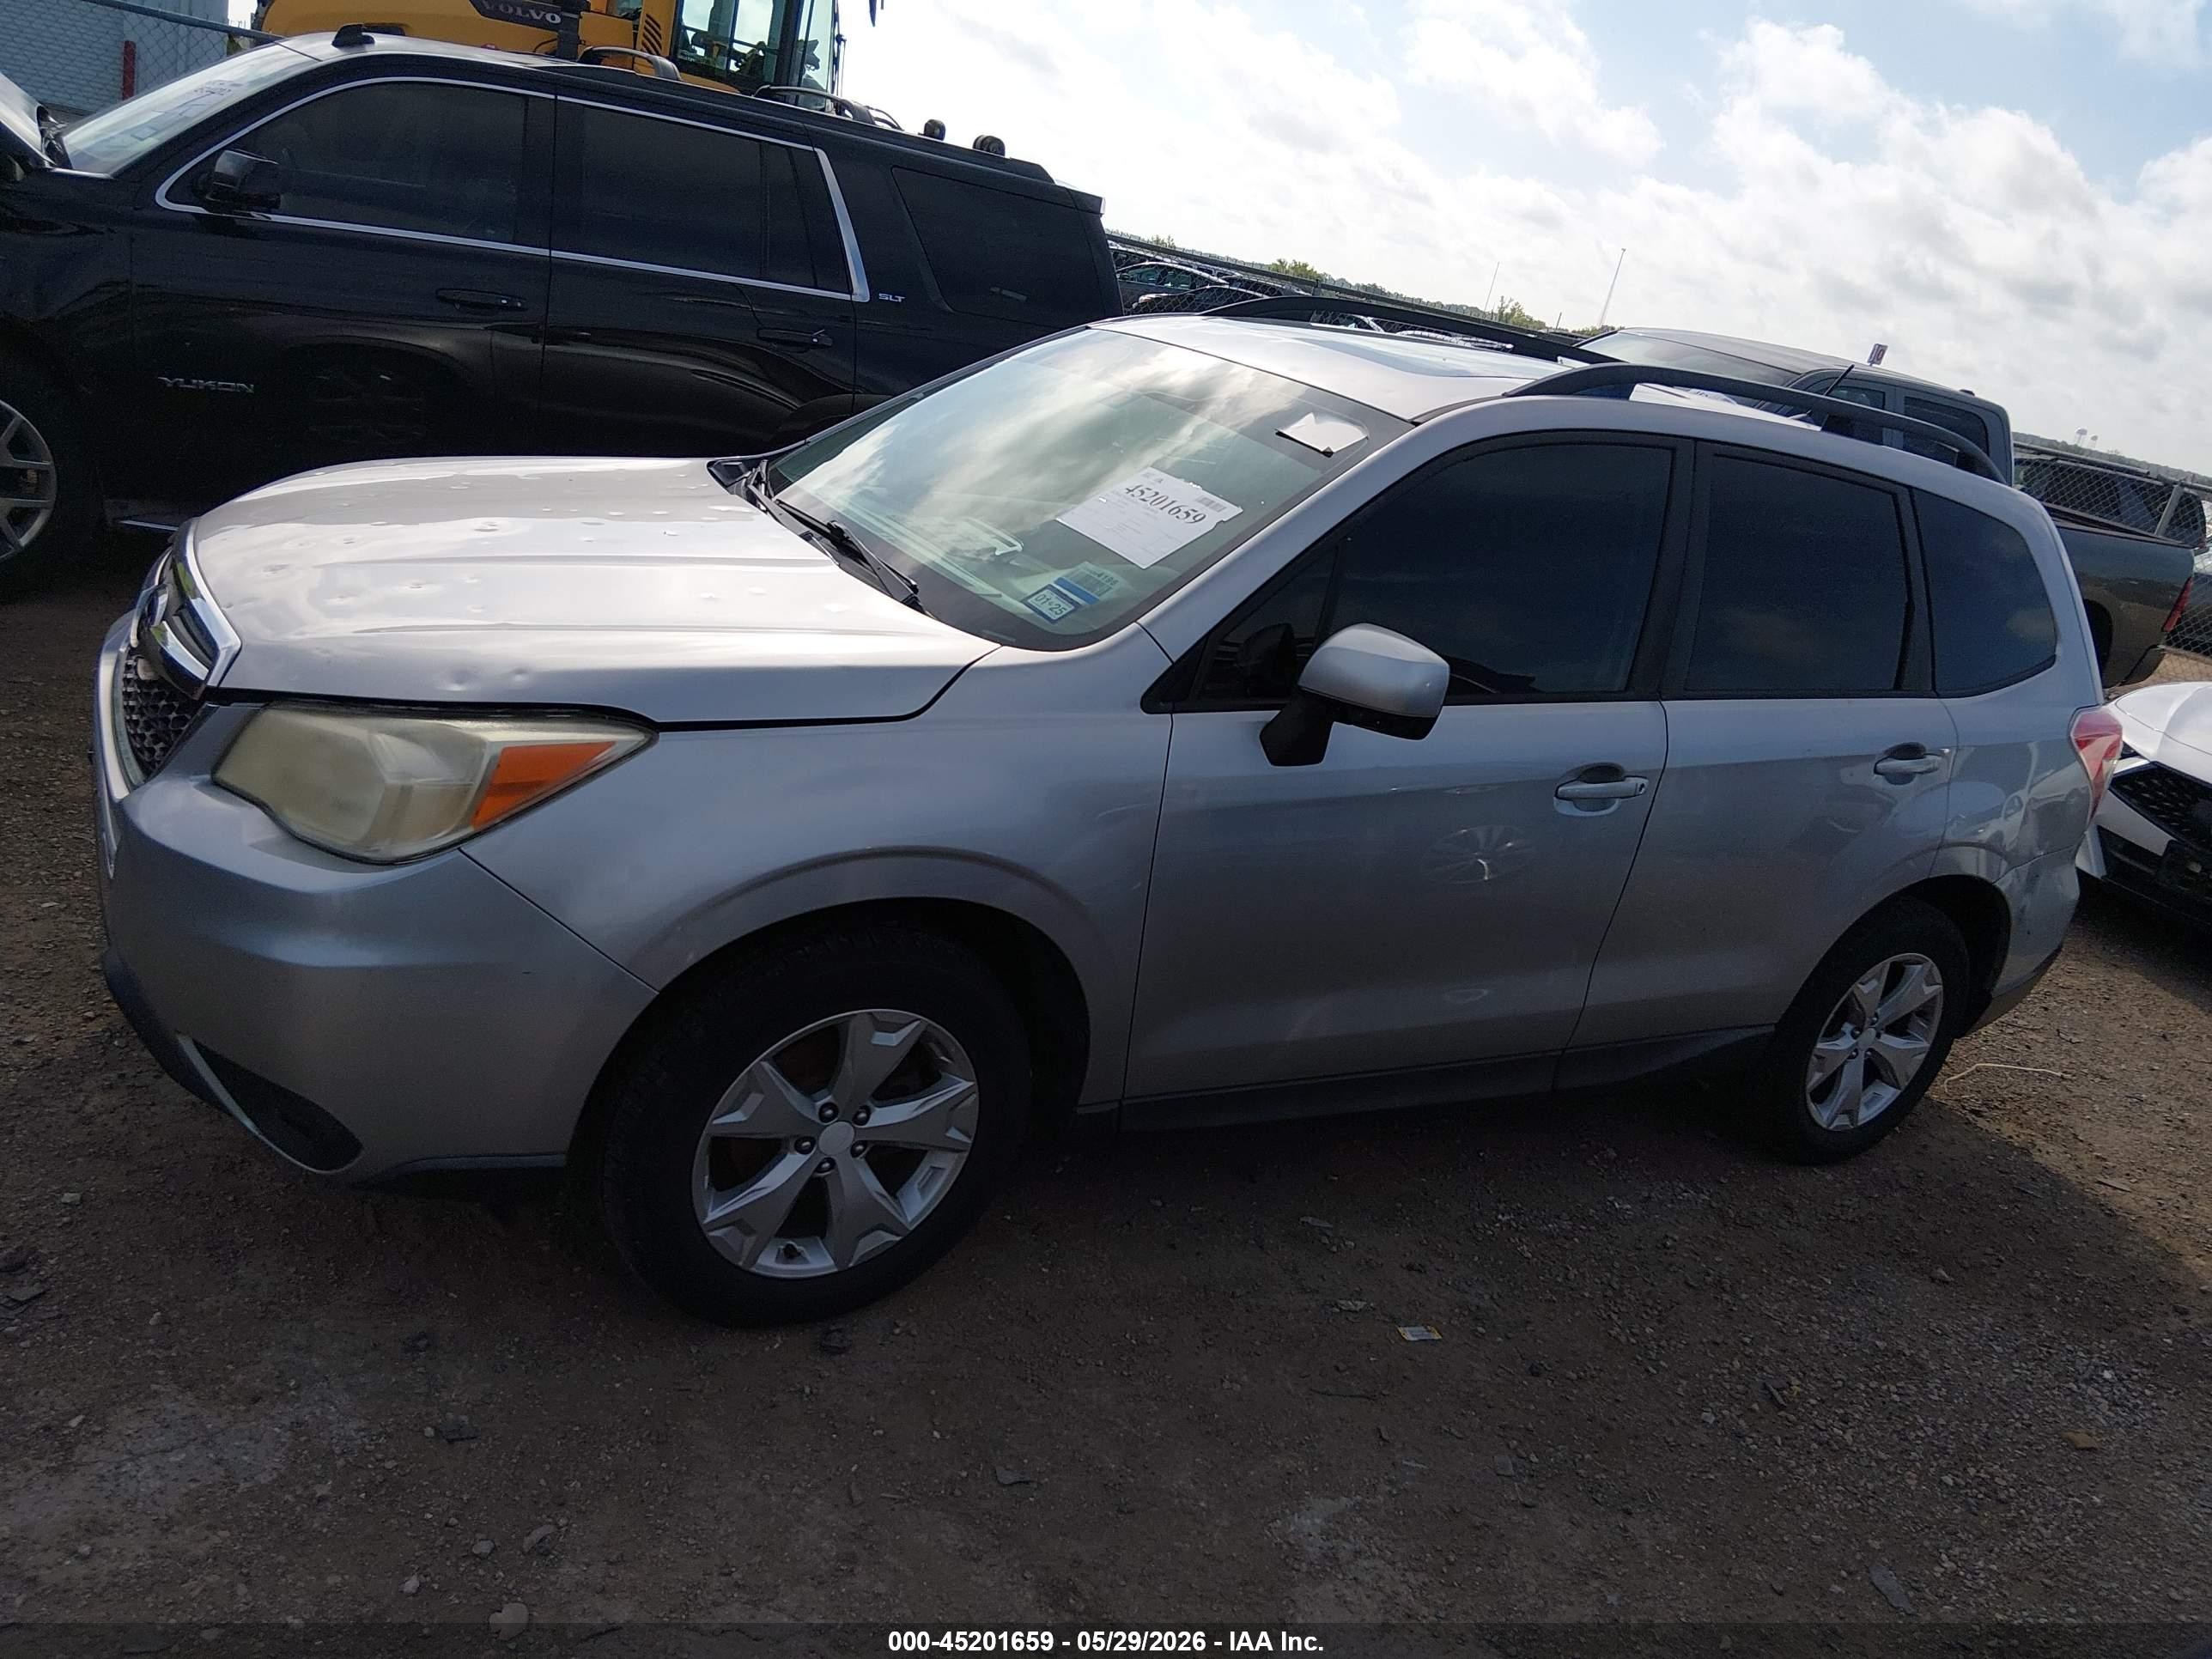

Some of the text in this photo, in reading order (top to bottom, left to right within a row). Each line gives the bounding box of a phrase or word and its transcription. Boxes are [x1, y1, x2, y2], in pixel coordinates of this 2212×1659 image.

[483, 0, 562, 24] VOLVO
[878, 293, 906, 302] SLT
[157, 376, 255, 394] YUKON
[1124, 483, 1207, 524] 45201659
